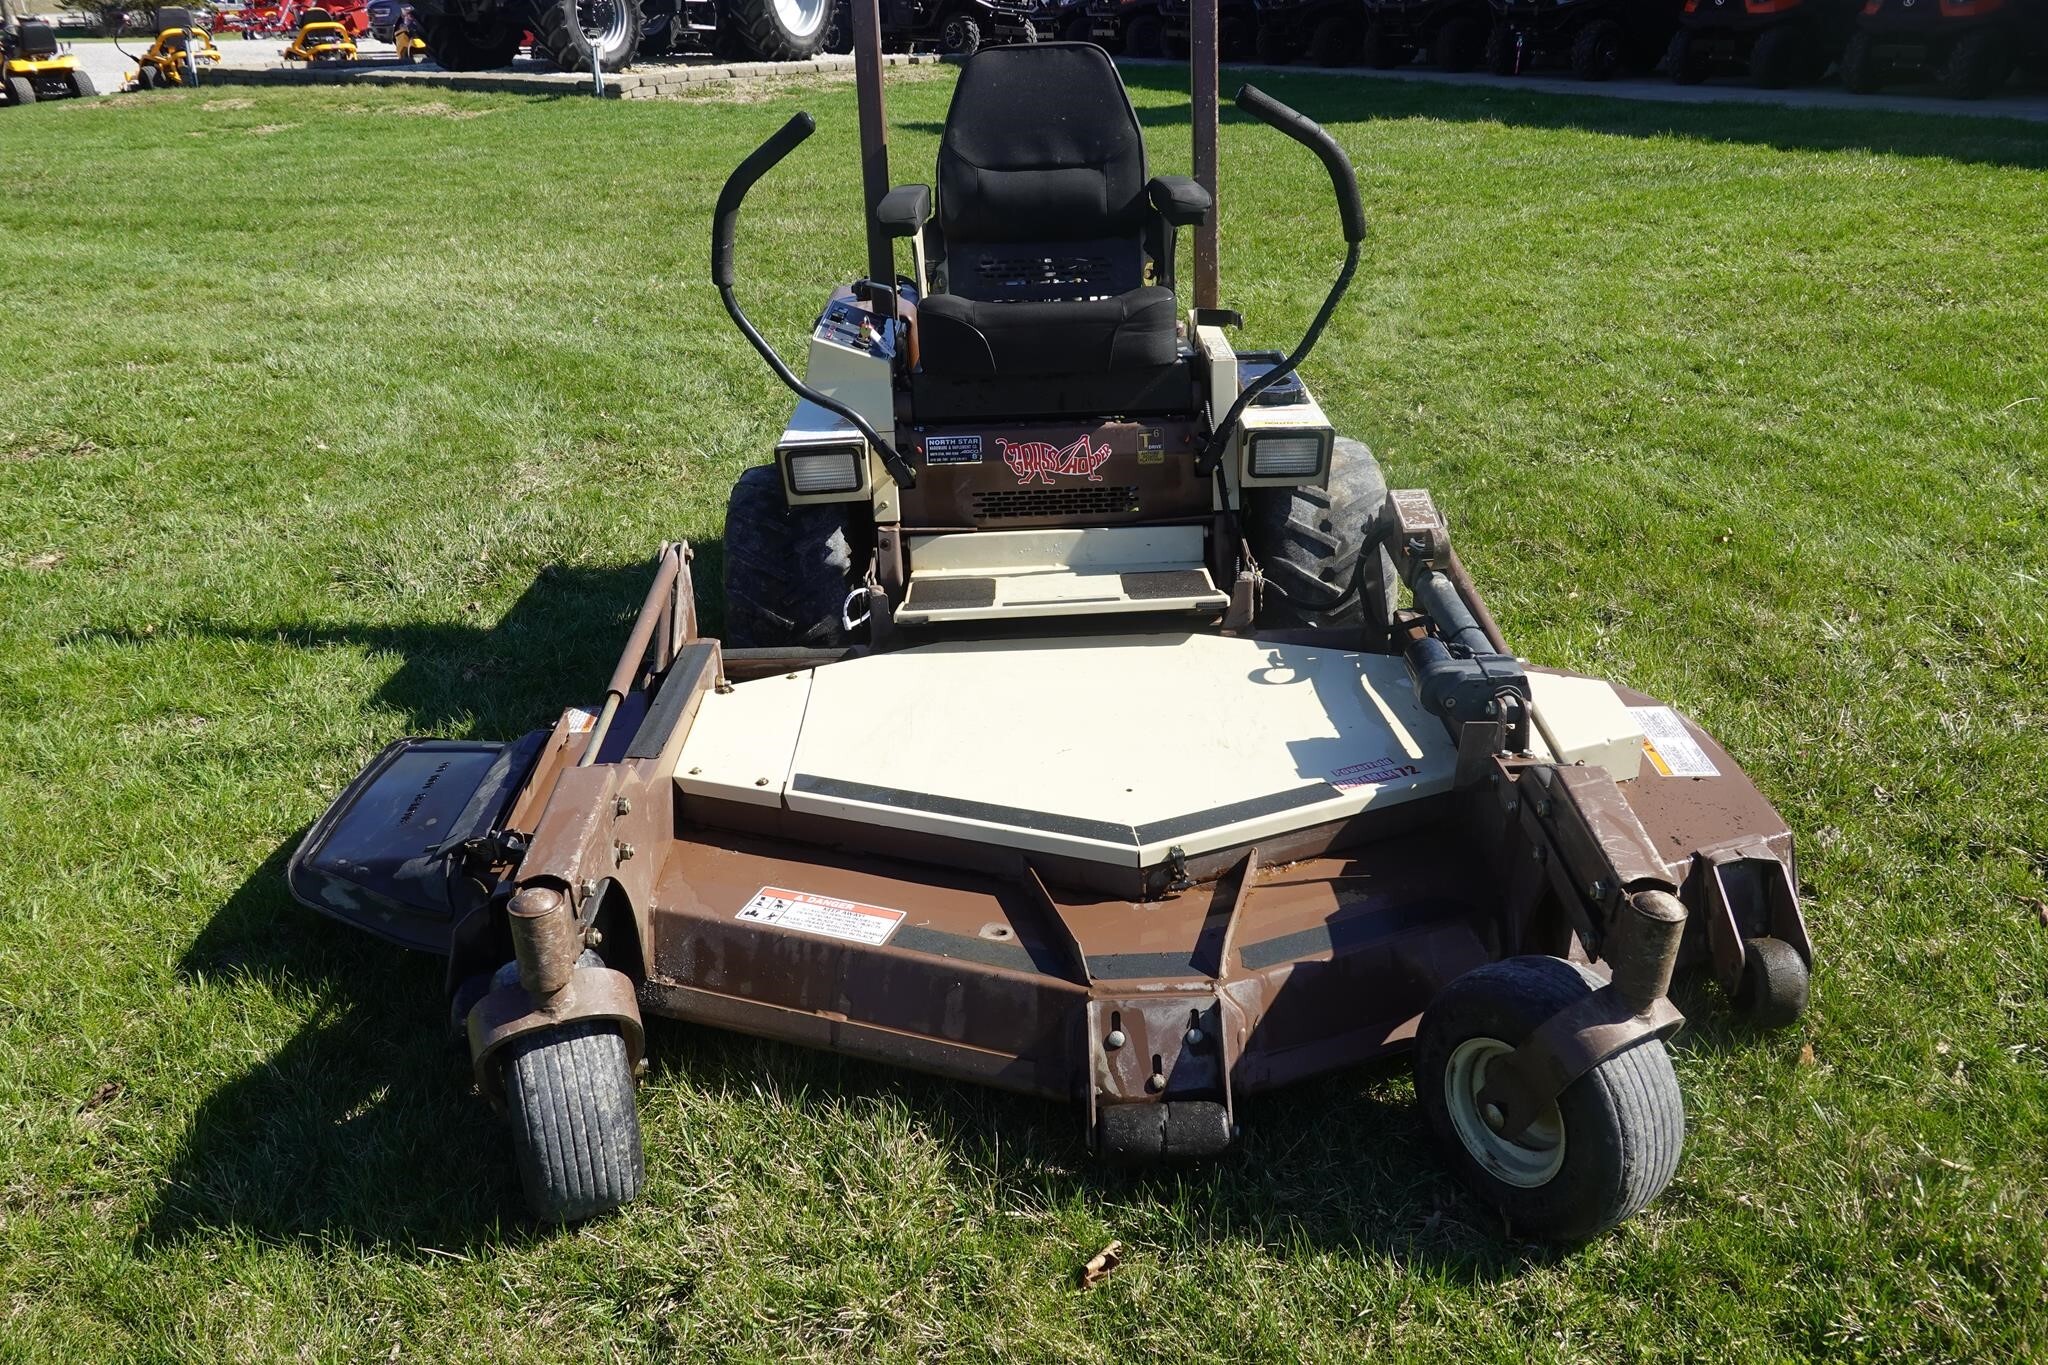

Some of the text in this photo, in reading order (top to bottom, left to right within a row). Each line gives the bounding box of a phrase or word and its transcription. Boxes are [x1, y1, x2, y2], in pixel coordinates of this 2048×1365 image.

[1139, 429, 1160, 448] T 6
[1396, 765, 1421, 777] 72
[806, 896, 855, 910] DANGER
